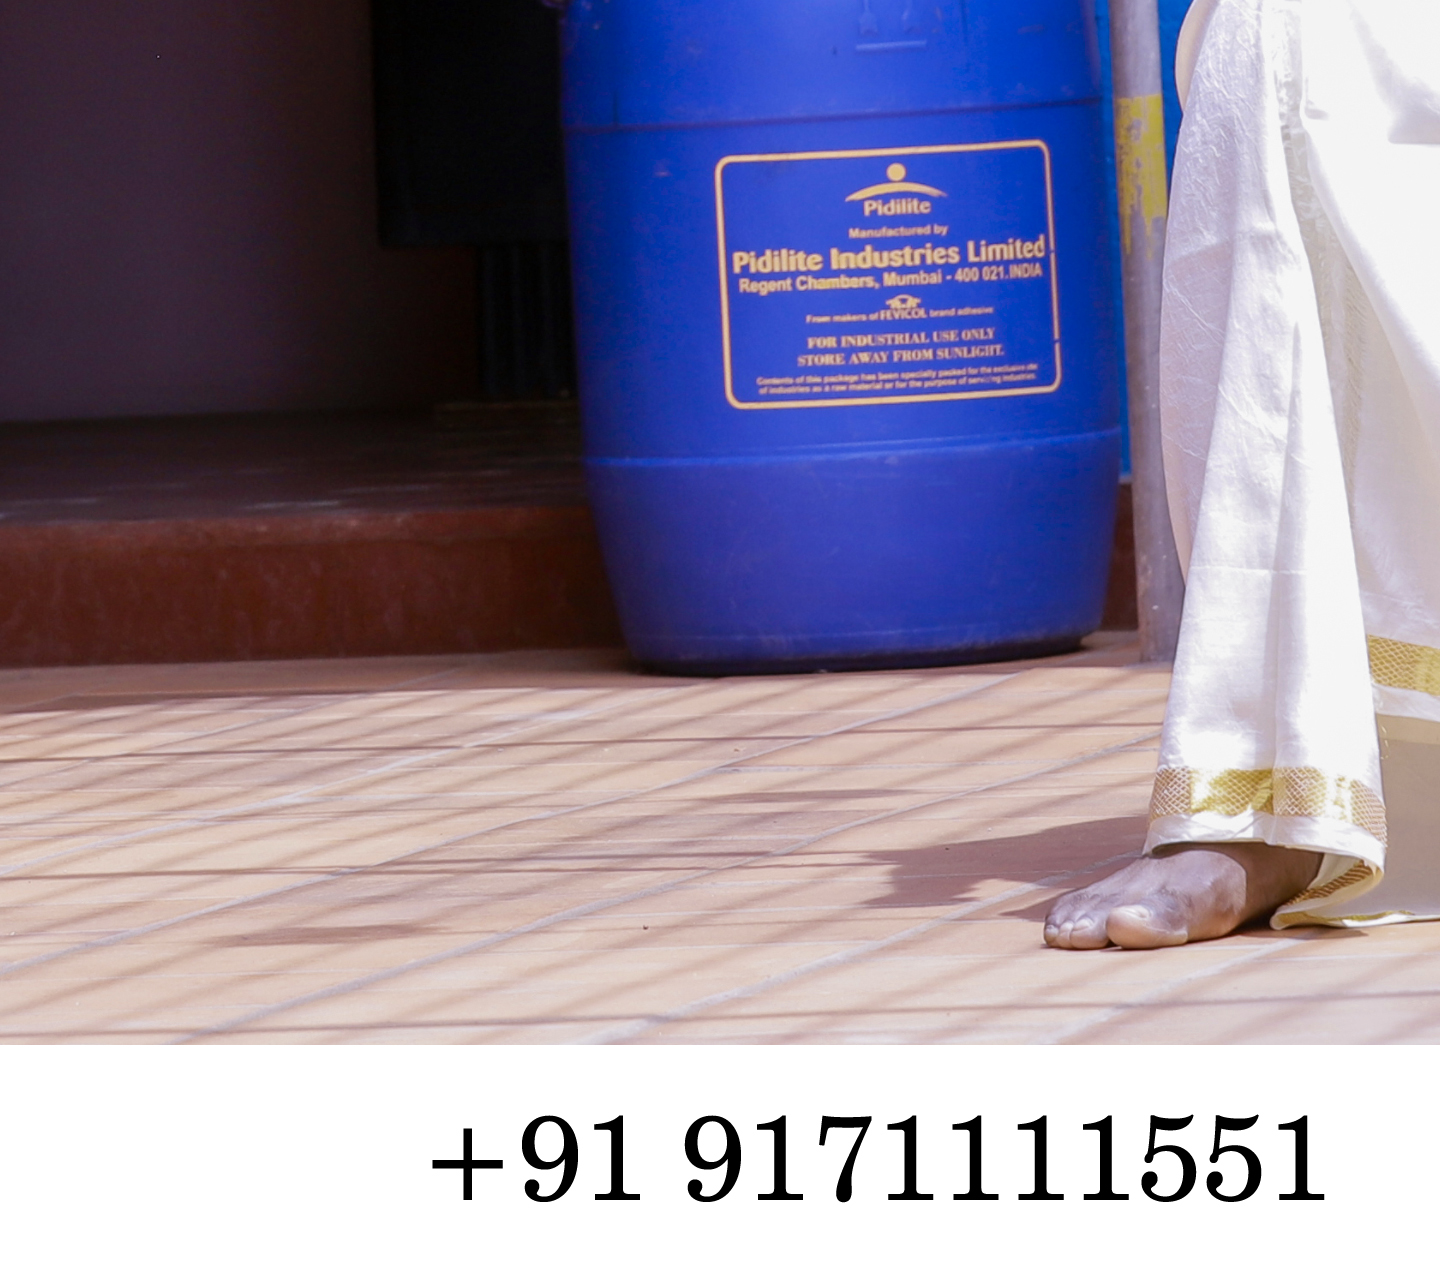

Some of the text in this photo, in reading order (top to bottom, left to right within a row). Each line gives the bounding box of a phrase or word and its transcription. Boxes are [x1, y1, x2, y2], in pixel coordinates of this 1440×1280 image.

[864, 197, 931, 216] Pidilite
[848, 223, 949, 238] Manufactured by
[733, 234, 1046, 273] Pidilite Industries Limited
[739, 277, 792, 295] Regent
[796, 274, 880, 290] Chambers,
[883, 270, 943, 286] Mumbai
[954, 267, 980, 282] 400
[880, 307, 928, 320] FEVICOL
[807, 327, 995, 348] FOR INDUSTRIAL USE ONLY
[798, 354, 846, 366] STORE
[849, 351, 889, 364] AWAY
[892, 349, 933, 362] FROM
